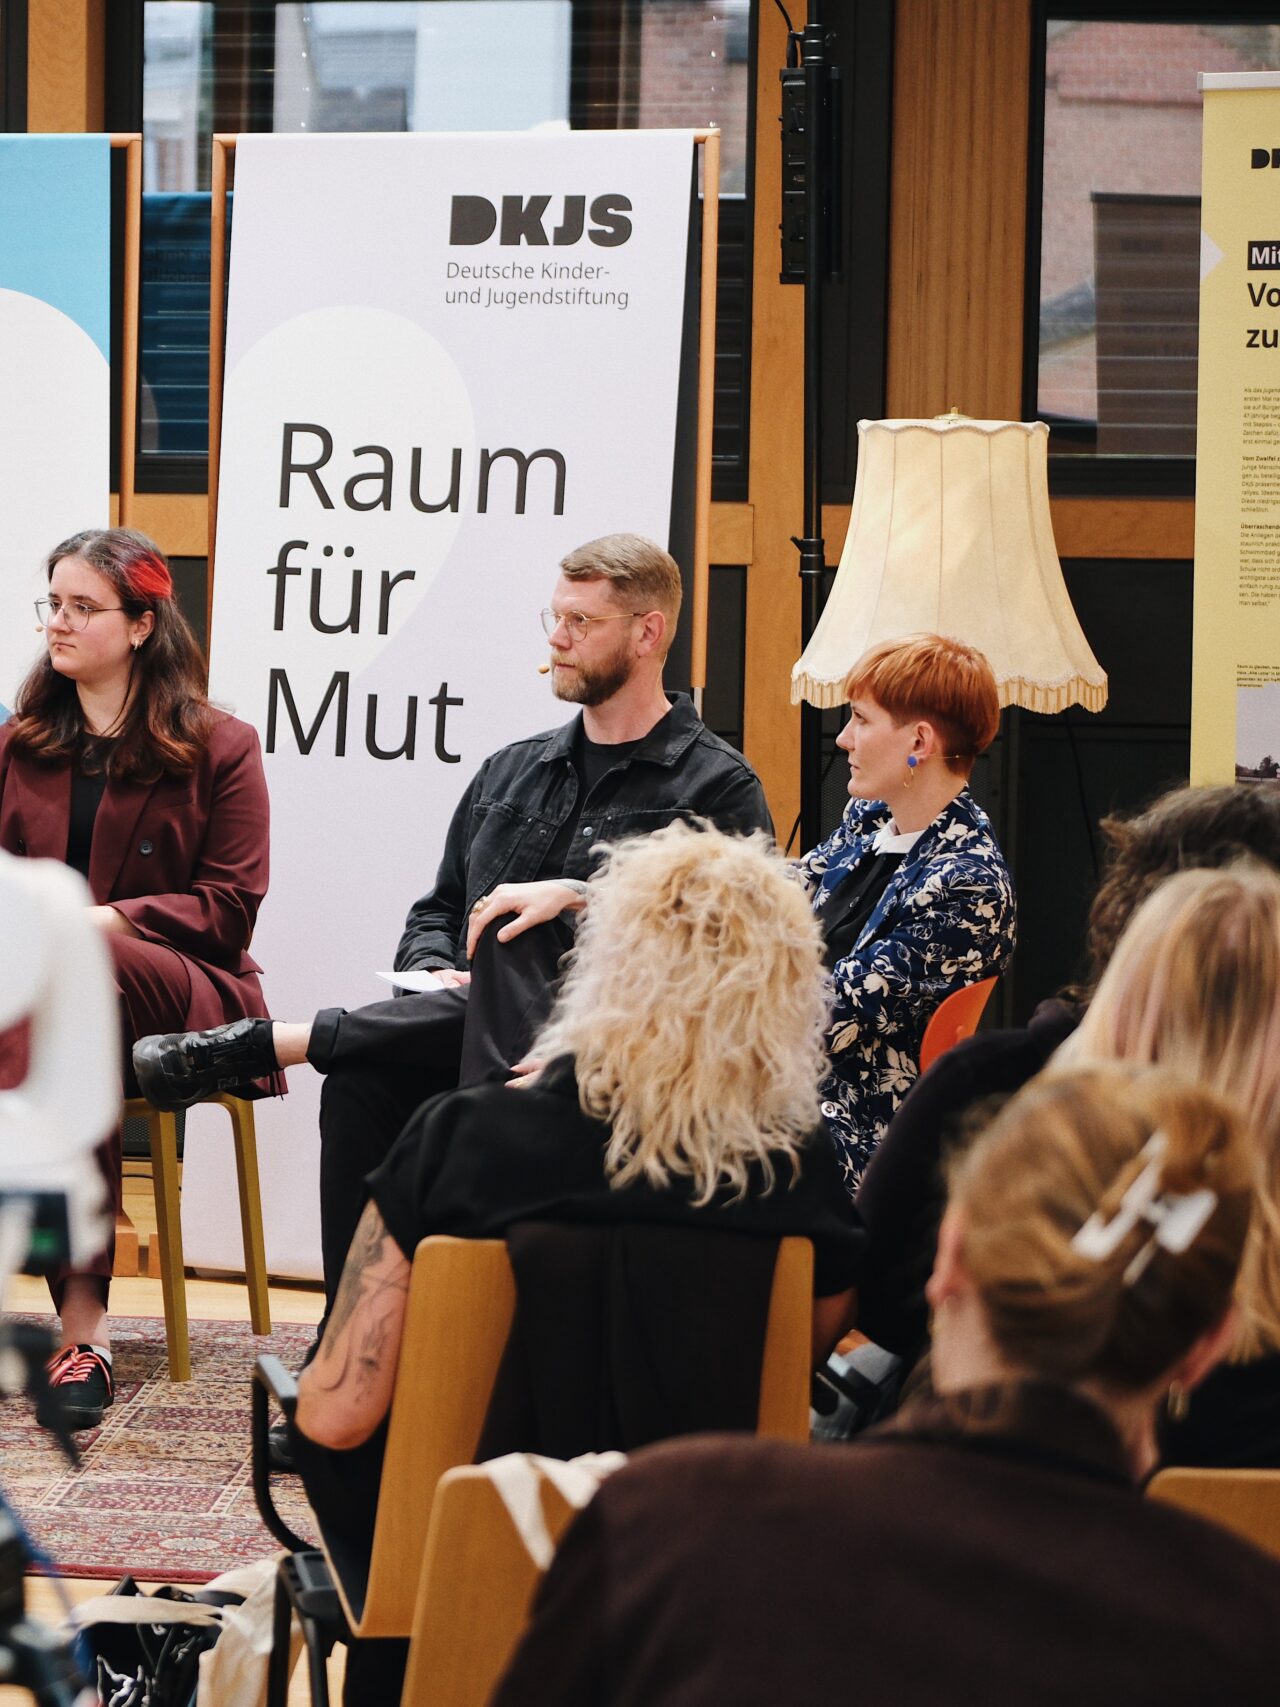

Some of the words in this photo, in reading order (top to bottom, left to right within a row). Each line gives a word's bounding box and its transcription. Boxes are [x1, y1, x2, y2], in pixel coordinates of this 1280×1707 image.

[449, 194, 632, 247] DKJS
[445, 288, 481, 304] und
[485, 288, 629, 310] Jugendstiftung
[446, 262, 534, 279] Deutsche
[541, 262, 610, 279] Kinder-
[279, 422, 566, 516] Raum
[266, 540, 416, 635] für
[265, 668, 464, 764] Mut
